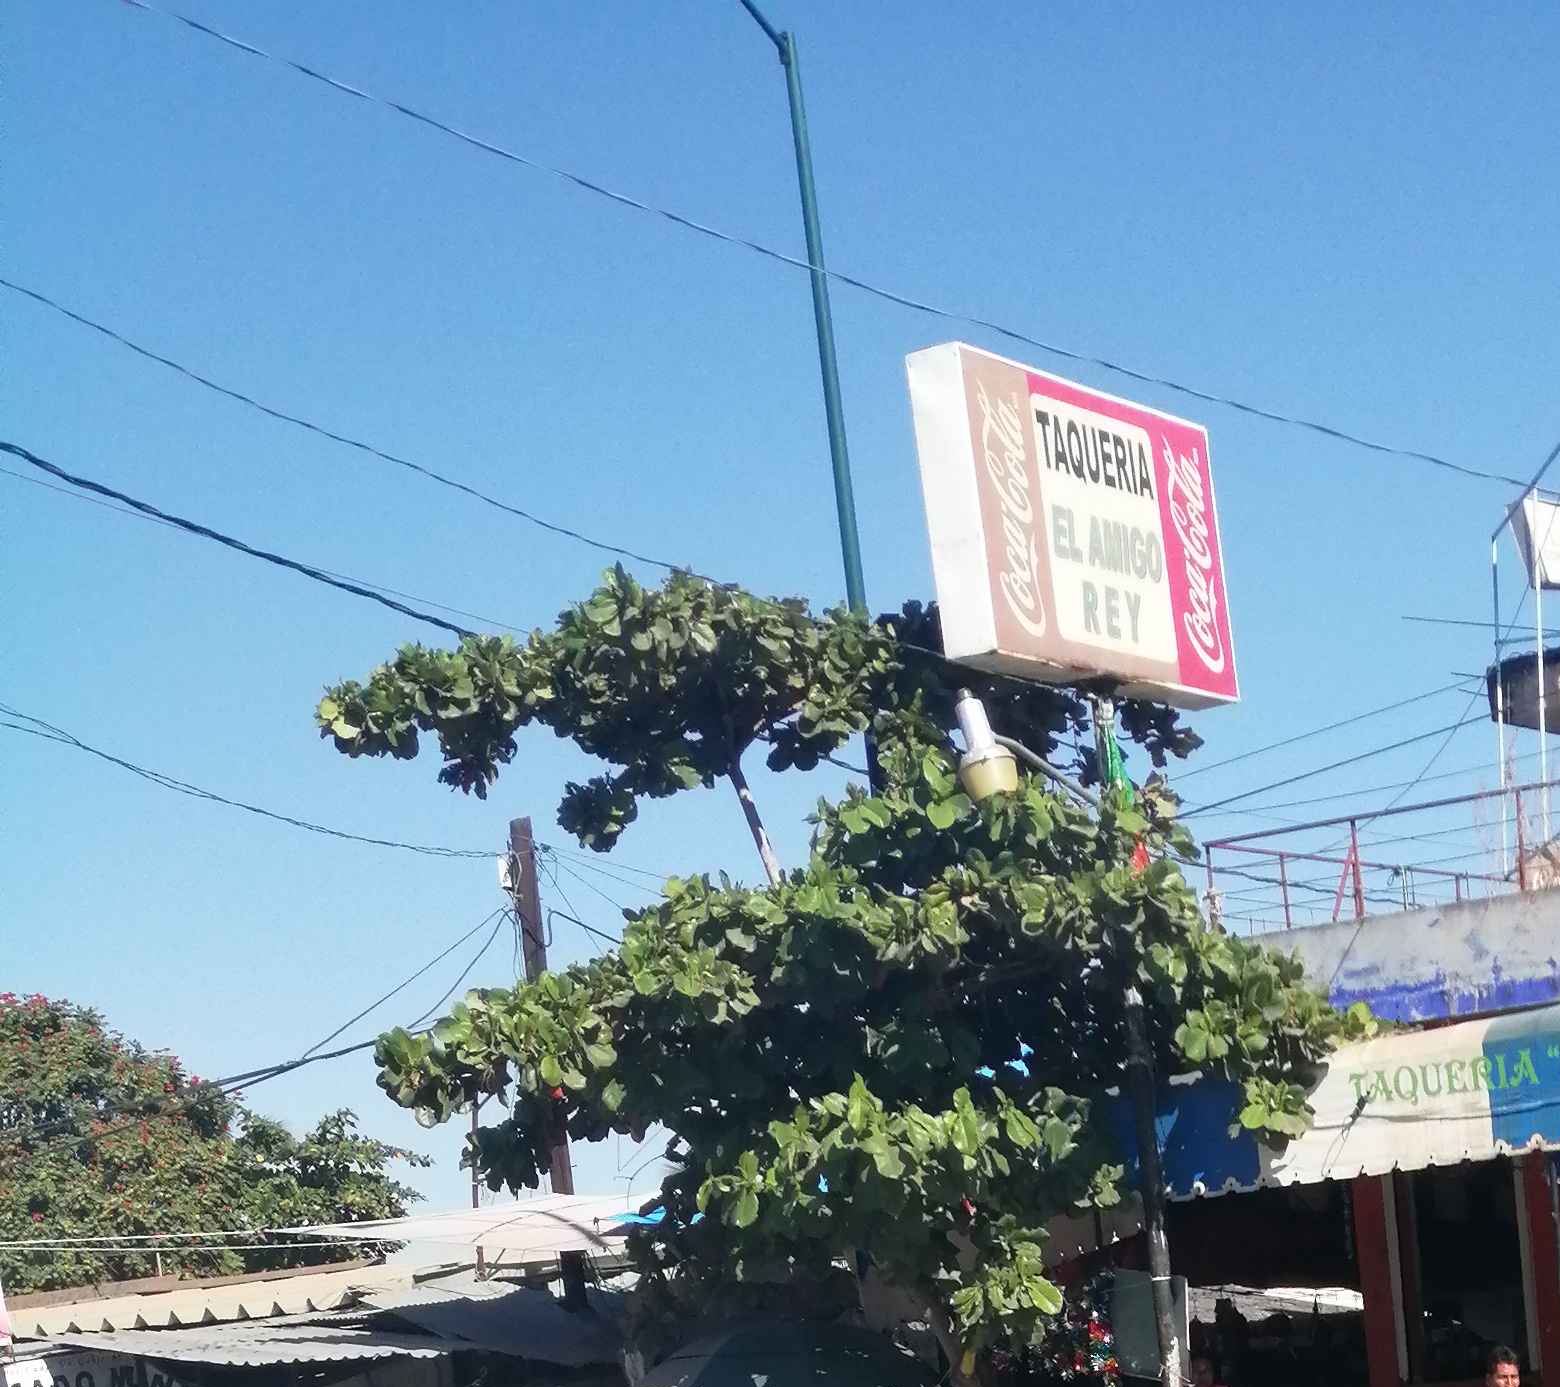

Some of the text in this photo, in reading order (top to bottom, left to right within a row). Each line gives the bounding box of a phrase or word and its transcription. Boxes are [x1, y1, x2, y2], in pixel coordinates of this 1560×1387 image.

[1035, 408, 1155, 501] TAQUERIA
[976, 377, 1046, 637] Coca-Cola
[1052, 503, 1163, 584] EL AMIGO
[1162, 432, 1225, 674] Coca-Cola
[1082, 579, 1141, 644] REY
[1348, 1047, 1539, 1107] TAQUERIA
